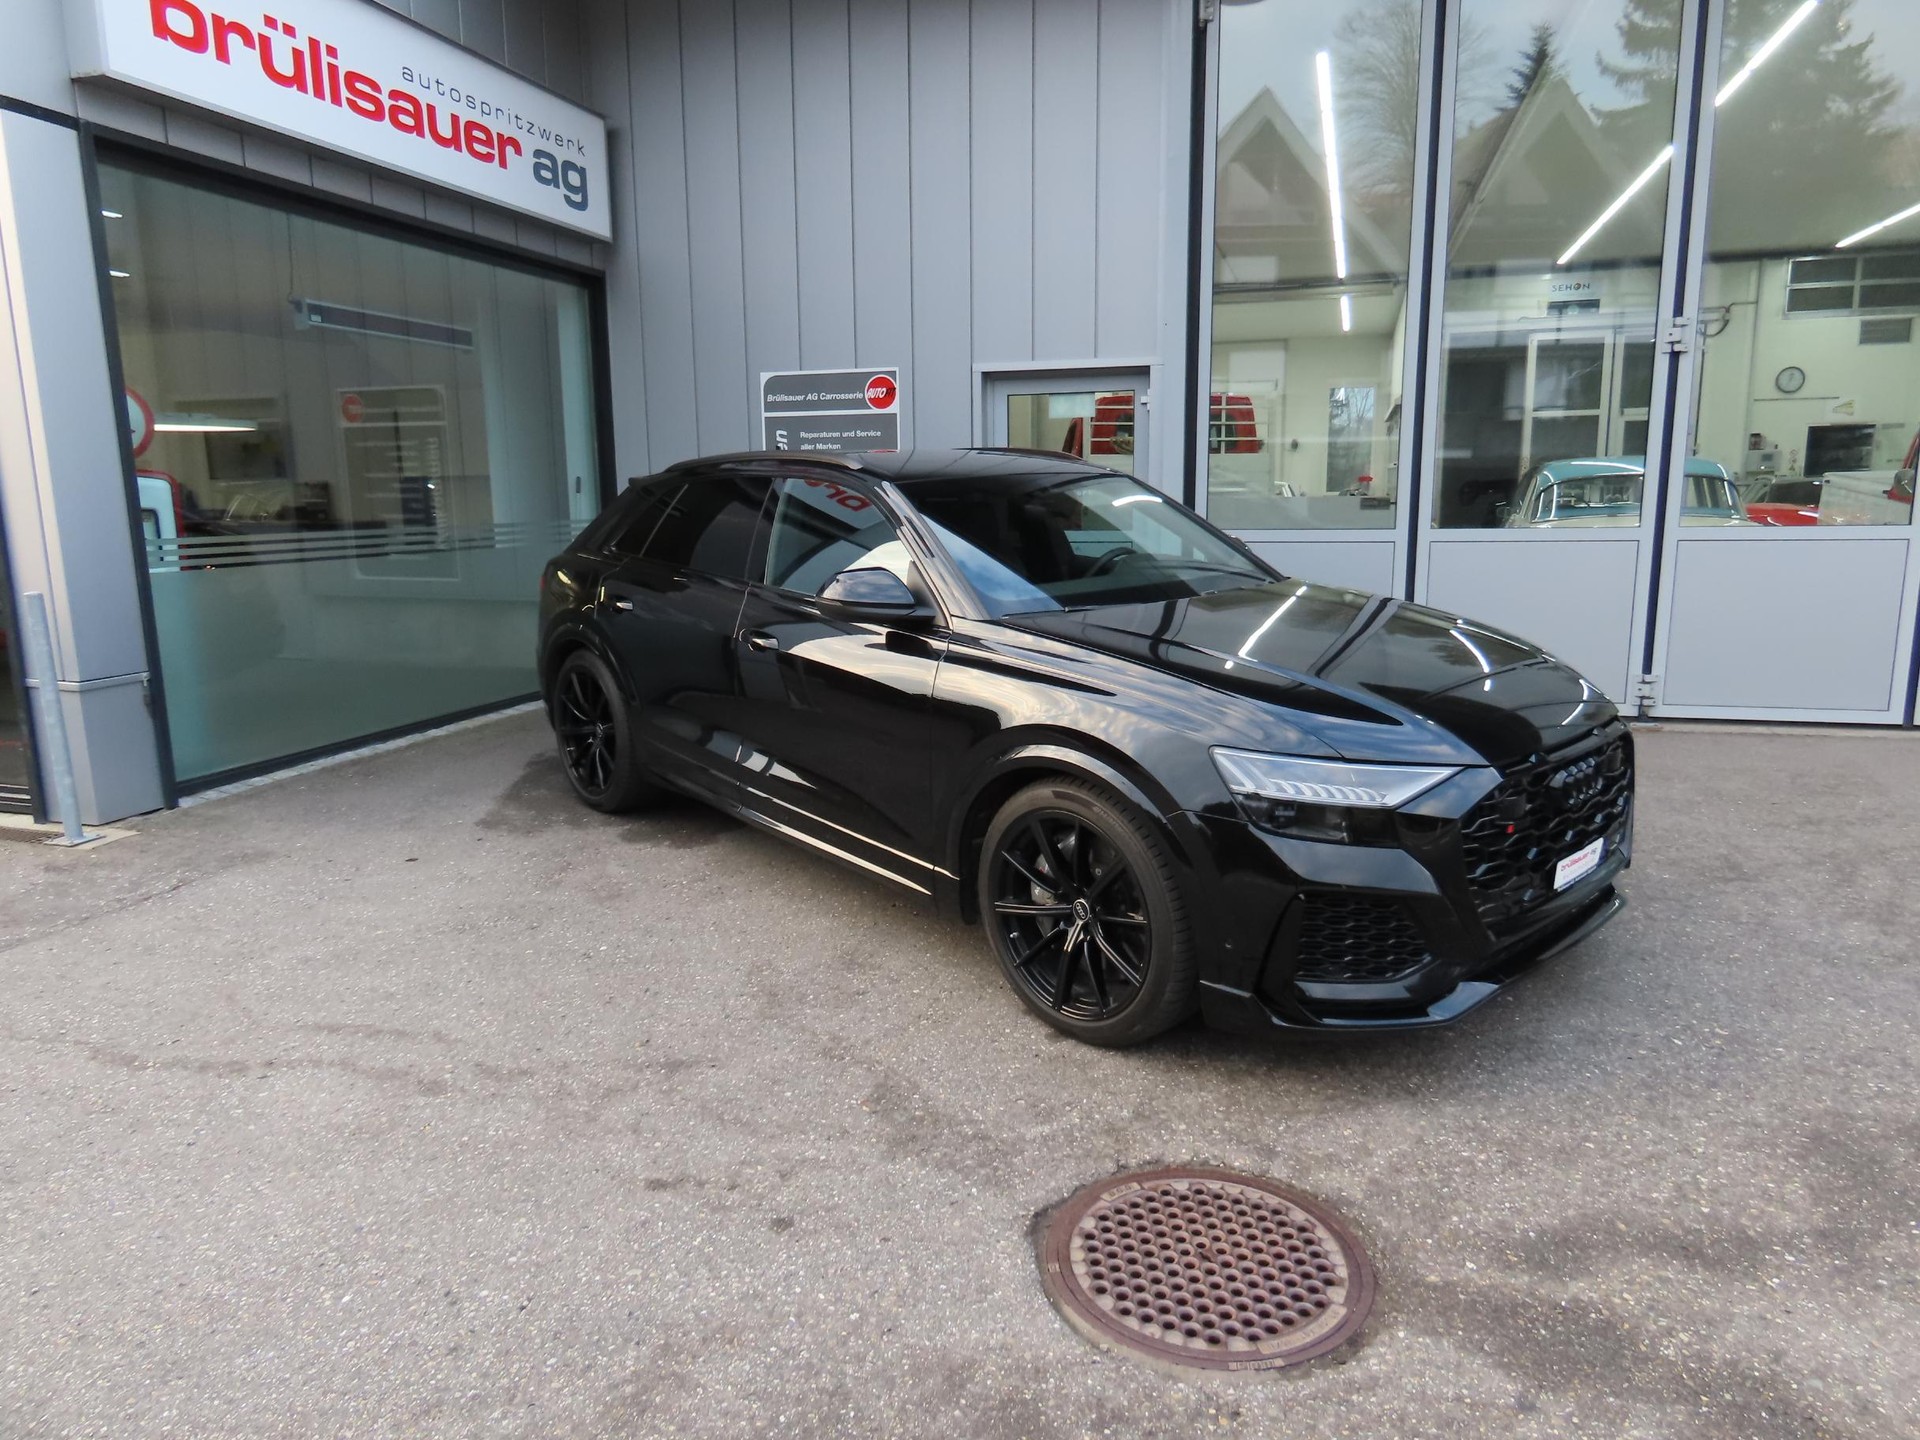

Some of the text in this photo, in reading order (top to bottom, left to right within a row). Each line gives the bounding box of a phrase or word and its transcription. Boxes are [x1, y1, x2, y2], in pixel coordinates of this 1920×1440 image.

[150, 0, 588, 212] brülisauer ag
[401, 66, 586, 157] autospritzwerk
[1552, 282, 1590, 292] SEHON
[767, 390, 863, 402] Brülisauer AG Carrosserie
[799, 431, 841, 439] Reparaturen
[856, 429, 881, 437] Service
[816, 442, 841, 450] Marken
